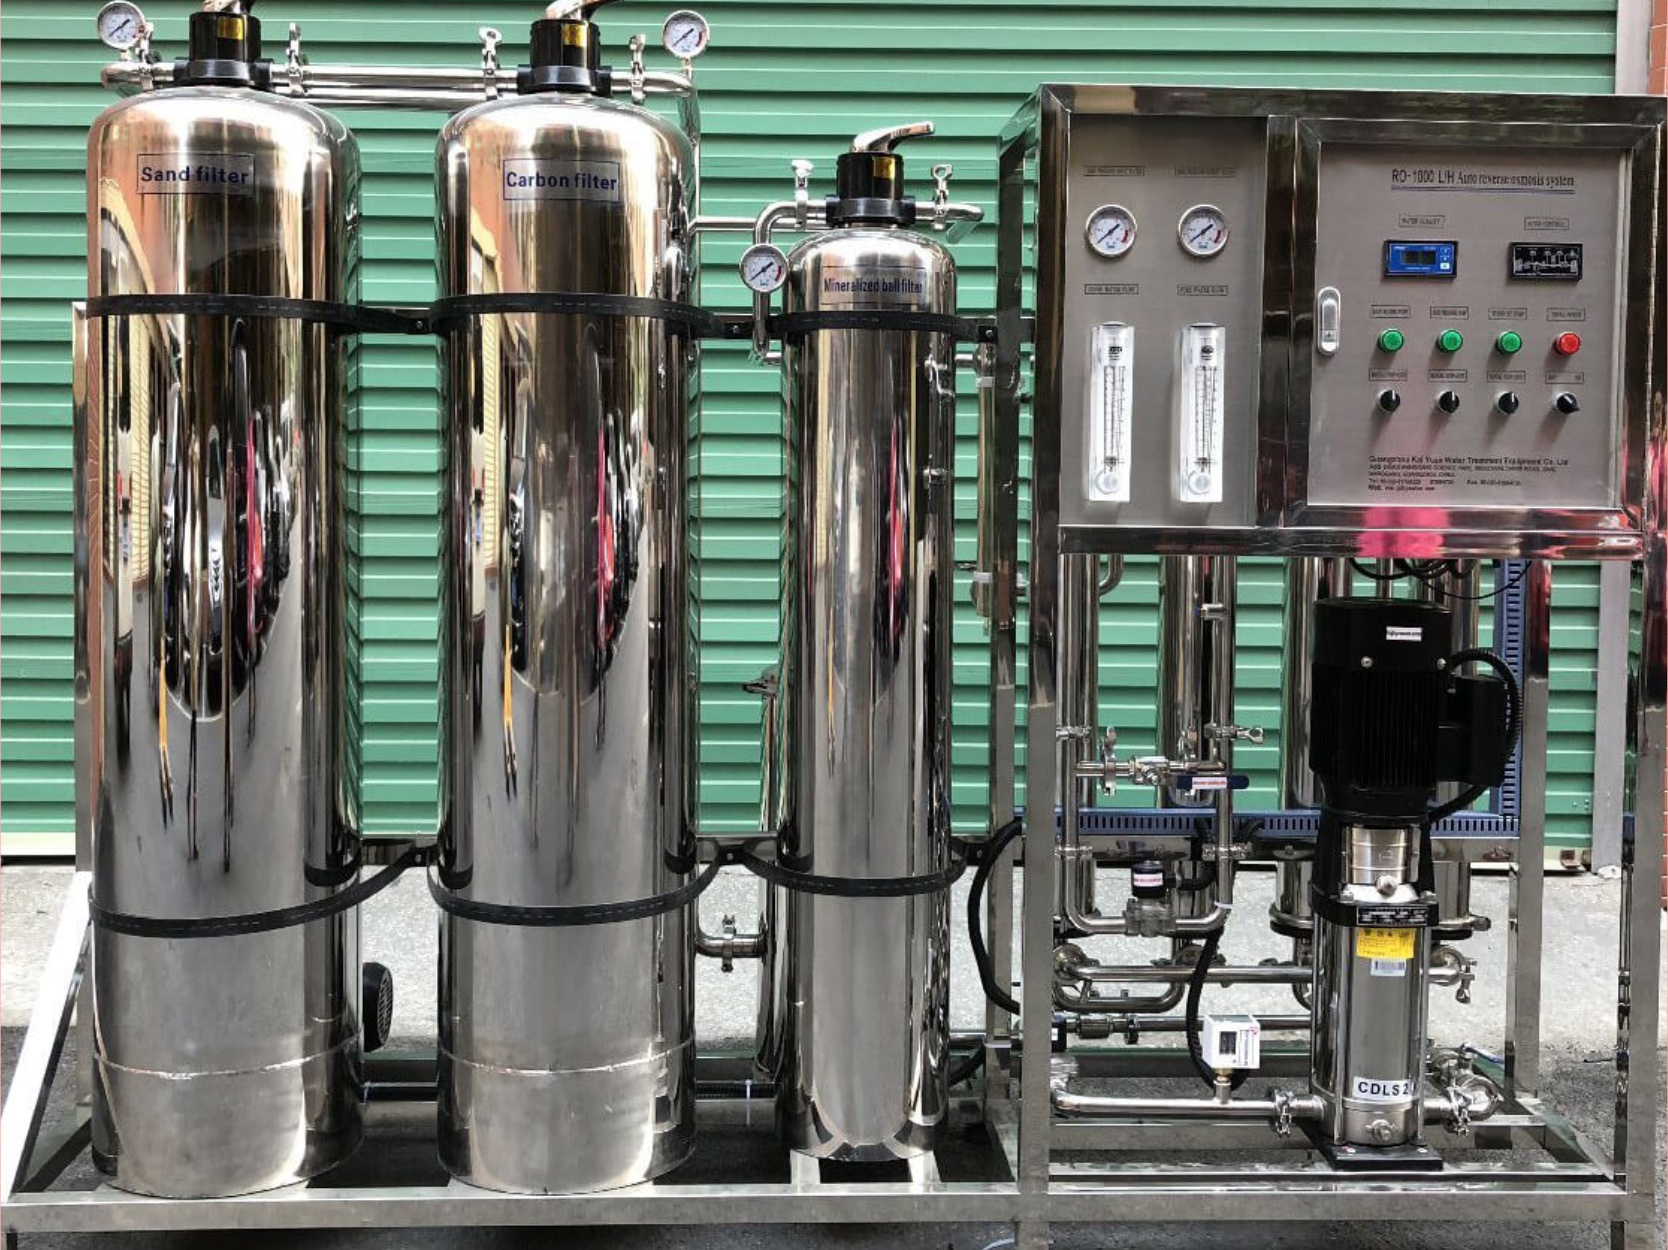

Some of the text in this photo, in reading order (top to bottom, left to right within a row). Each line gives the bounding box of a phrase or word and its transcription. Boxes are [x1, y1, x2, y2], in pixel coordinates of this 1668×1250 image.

[141, 166, 249, 184] Sand filter
[506, 170, 617, 190] Carbon filter
[1458, 171, 1477, 184] Auto
[1546, 175, 1575, 188] system
[824, 278, 879, 292] Mineralized
[882, 278, 900, 293] ball
